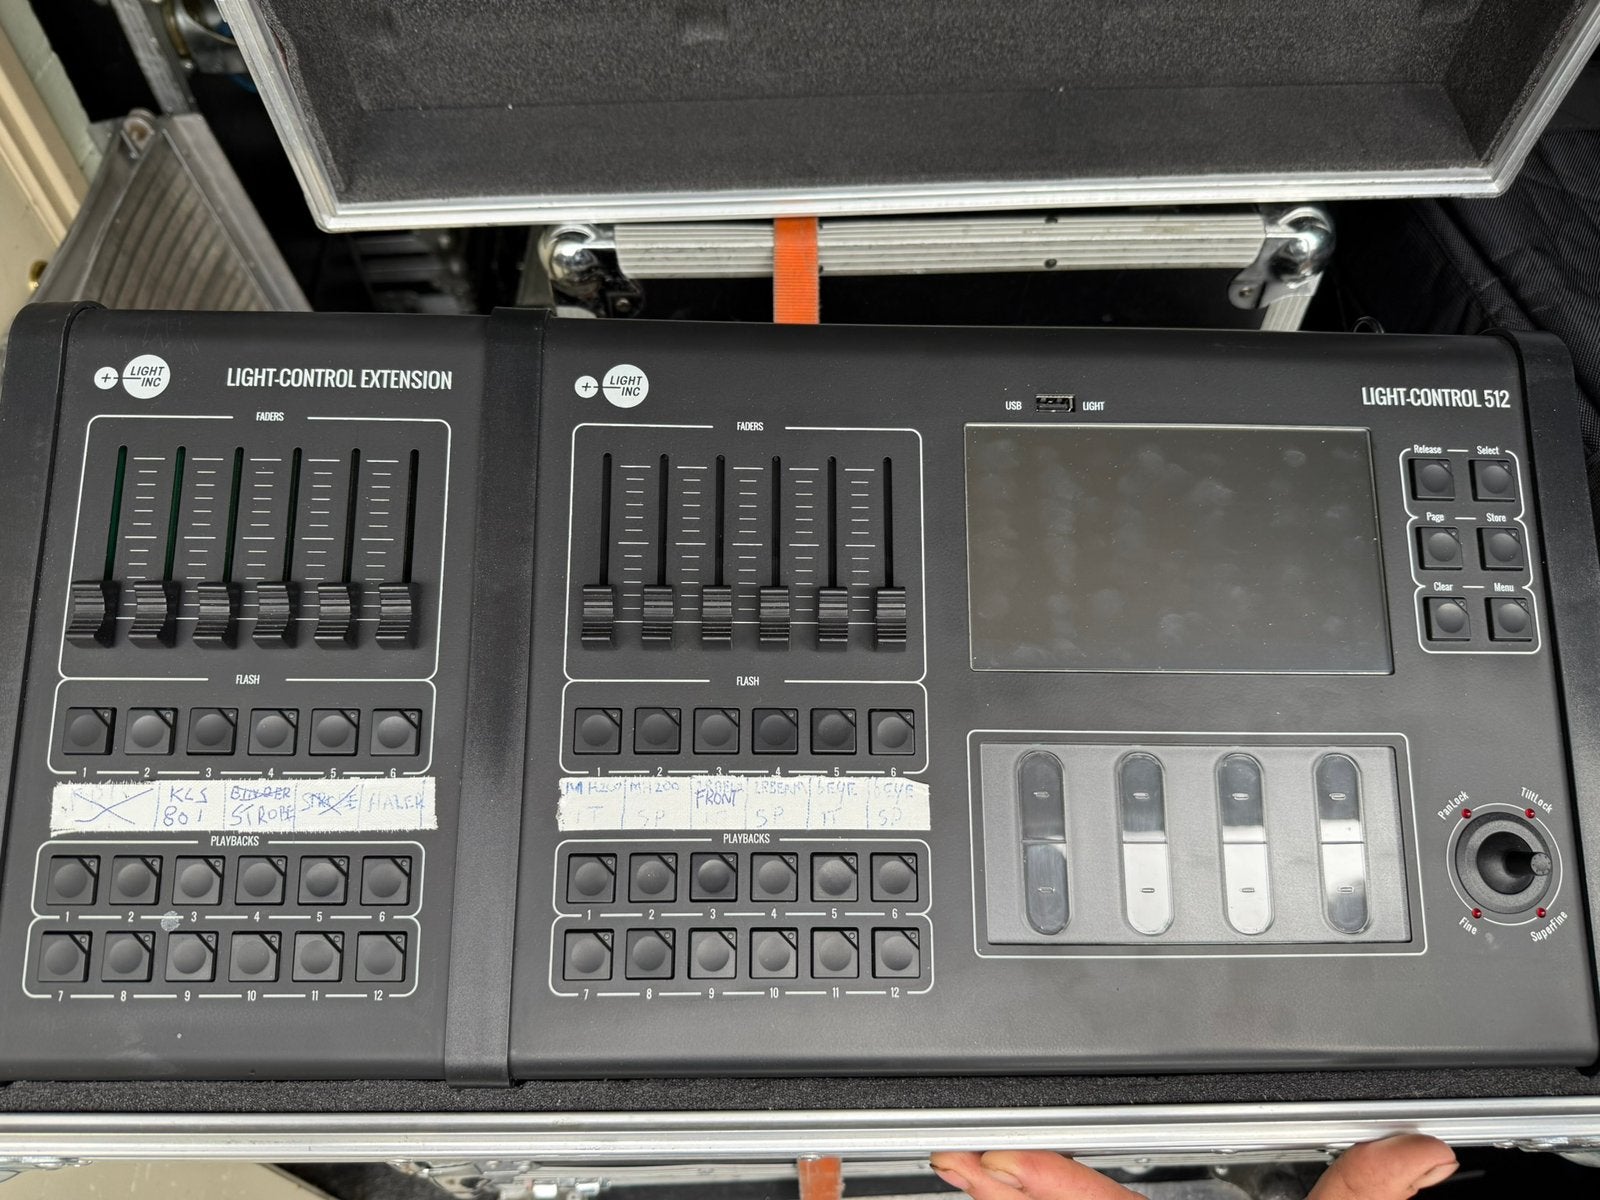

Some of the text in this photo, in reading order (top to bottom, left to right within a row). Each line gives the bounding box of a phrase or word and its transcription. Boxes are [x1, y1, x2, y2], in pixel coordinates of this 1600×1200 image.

[129, 366, 165, 377] LIGHT
[141, 377, 162, 388] INC
[226, 367, 453, 390] LIGHT-CONTROL EXTENSION
[609, 375, 643, 386] LIGHT
[620, 386, 641, 397] INC
[1361, 386, 1511, 408] LIGHT-CONTROL 512
[1005, 400, 1023, 411] USB
[1082, 401, 1105, 411] LIGHT
[255, 411, 285, 422] FADERS
[736, 421, 764, 432] FADERS
[1413, 444, 1442, 454] Release
[1476, 445, 1500, 455] Select
[1426, 511, 1445, 523] Page
[1486, 512, 1507, 523] Store
[1433, 581, 1454, 592] Clear
[1493, 582, 1515, 592] Menu
[235, 674, 261, 685] FLASH
[736, 675, 760, 687] FLASH
[83, 767, 87, 778] 1
[143, 767, 151, 778] 2
[205, 767, 212, 778] 3
[267, 768, 274, 778] 4
[330, 768, 337, 778] 5
[390, 768, 397, 778] 6
[597, 767, 601, 777] 1
[656, 766, 663, 777] 2
[715, 766, 722, 776] 3
[775, 766, 781, 776] 4
[833, 767, 840, 777] 5
[890, 767, 897, 777] 6
[695, 788, 744, 809] FRONT
[1520, 786, 1553, 814] TiltLock
[1437, 790, 1470, 821] PanLock
[210, 835, 260, 847] PLAYBACKS
[723, 833, 771, 844] PLAYBACKS
[65, 911, 70, 923] 1
[127, 910, 135, 923] 2
[190, 911, 198, 923] 3
[253, 911, 260, 923] 4
[316, 911, 323, 923] 5
[379, 911, 386, 922] 6
[587, 909, 591, 921] 1
[648, 908, 655, 920] 2
[710, 908, 716, 920] 3
[770, 908, 777, 919] 4
[831, 907, 838, 919] 5
[891, 907, 898, 919] 6
[1458, 916, 1478, 936] Fine
[1530, 911, 1568, 942] SuperFine
[58, 990, 64, 1002] 7
[120, 990, 127, 1002] 8
[184, 990, 191, 1002] 9
[247, 989, 257, 1002] 10
[311, 989, 319, 1001] 11
[374, 989, 383, 1001] 12
[583, 988, 589, 1001] 7
[646, 987, 653, 1000] 8
[708, 987, 715, 999] 9
[769, 987, 779, 999] 10
[832, 986, 840, 999] 11
[890, 986, 900, 998] 12
